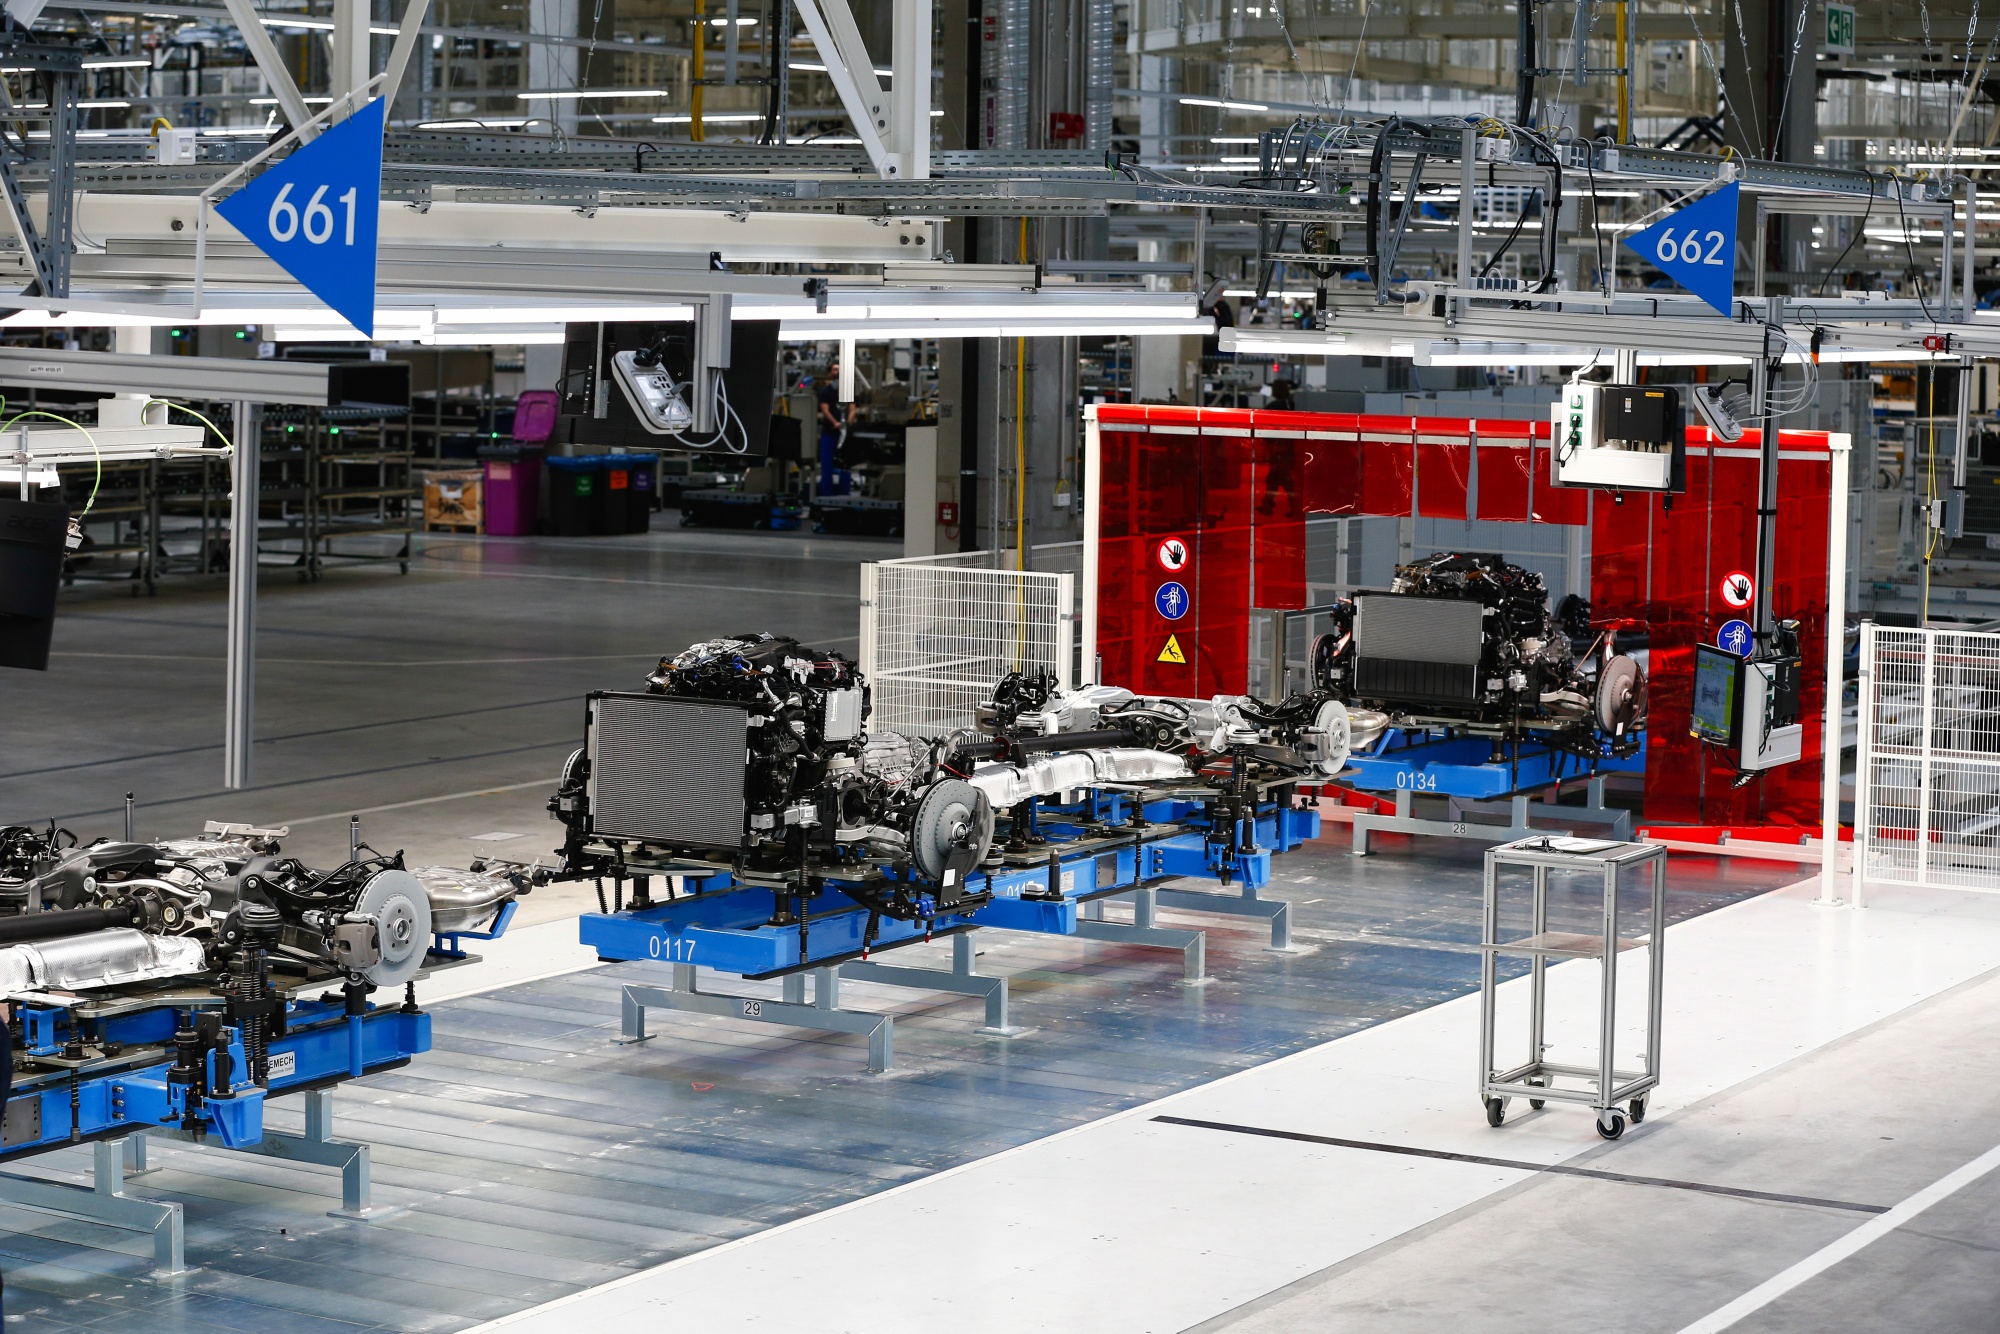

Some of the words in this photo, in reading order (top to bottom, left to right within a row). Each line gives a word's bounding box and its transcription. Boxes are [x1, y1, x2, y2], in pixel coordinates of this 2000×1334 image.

[268, 182, 357, 246] 661
[1656, 227, 1725, 266] 662
[1396, 771, 1437, 791] 0134
[1453, 823, 1466, 834] 28
[650, 935, 696, 962] 0117
[744, 1001, 760, 1016] 29
[268, 1055, 294, 1069] EMECH
